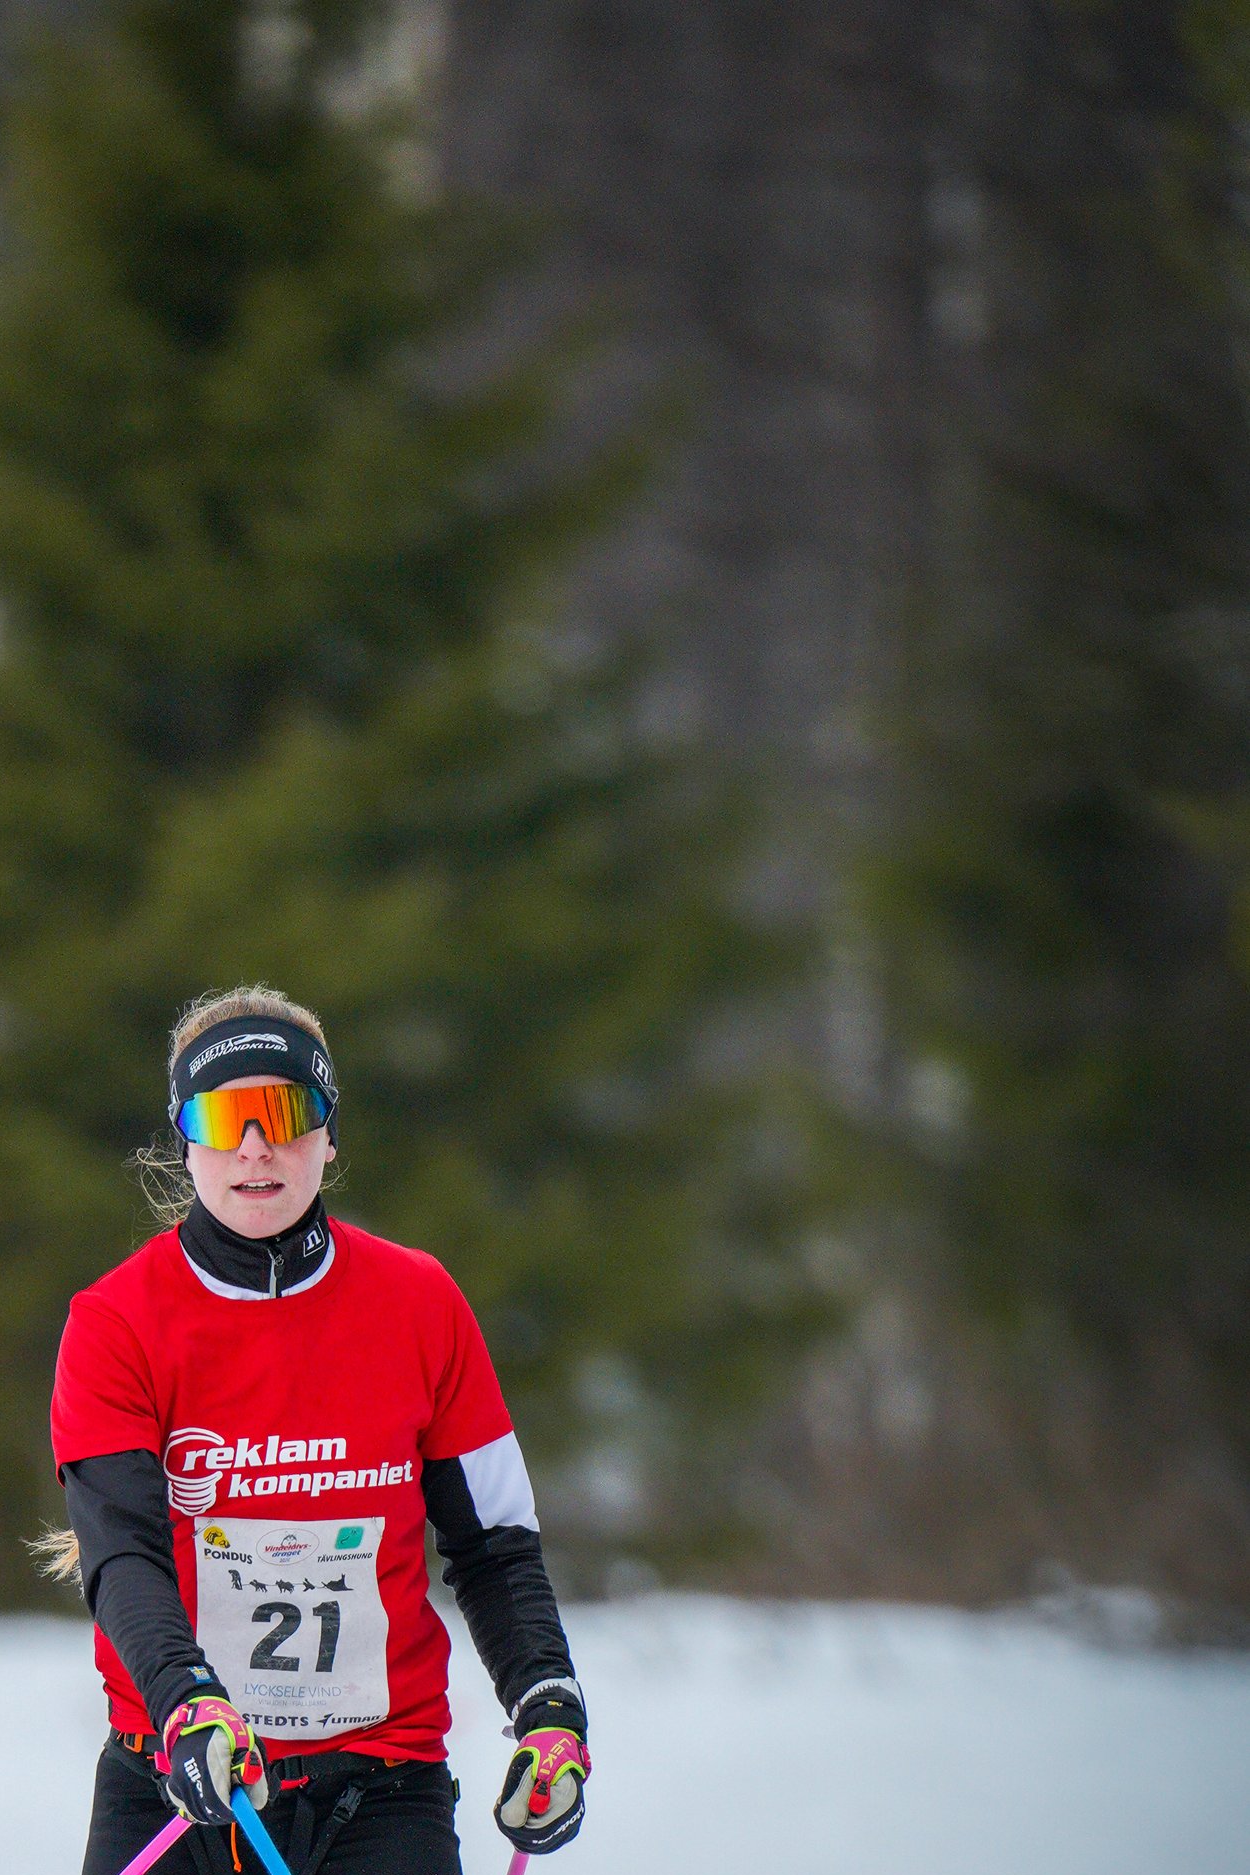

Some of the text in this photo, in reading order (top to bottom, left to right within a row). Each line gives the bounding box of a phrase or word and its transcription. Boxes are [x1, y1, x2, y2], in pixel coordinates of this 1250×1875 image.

[182, 1435, 347, 1472] reklam
[228, 1460, 413, 1498] kompaniet
[204, 1548, 253, 1565] PONDUS
[317, 1552, 373, 1563] TÄVLINGSHUND
[250, 1600, 341, 1673] 21
[244, 1683, 342, 1698] LYCKSELE VIND
[540, 1737, 572, 1775] LEKI
